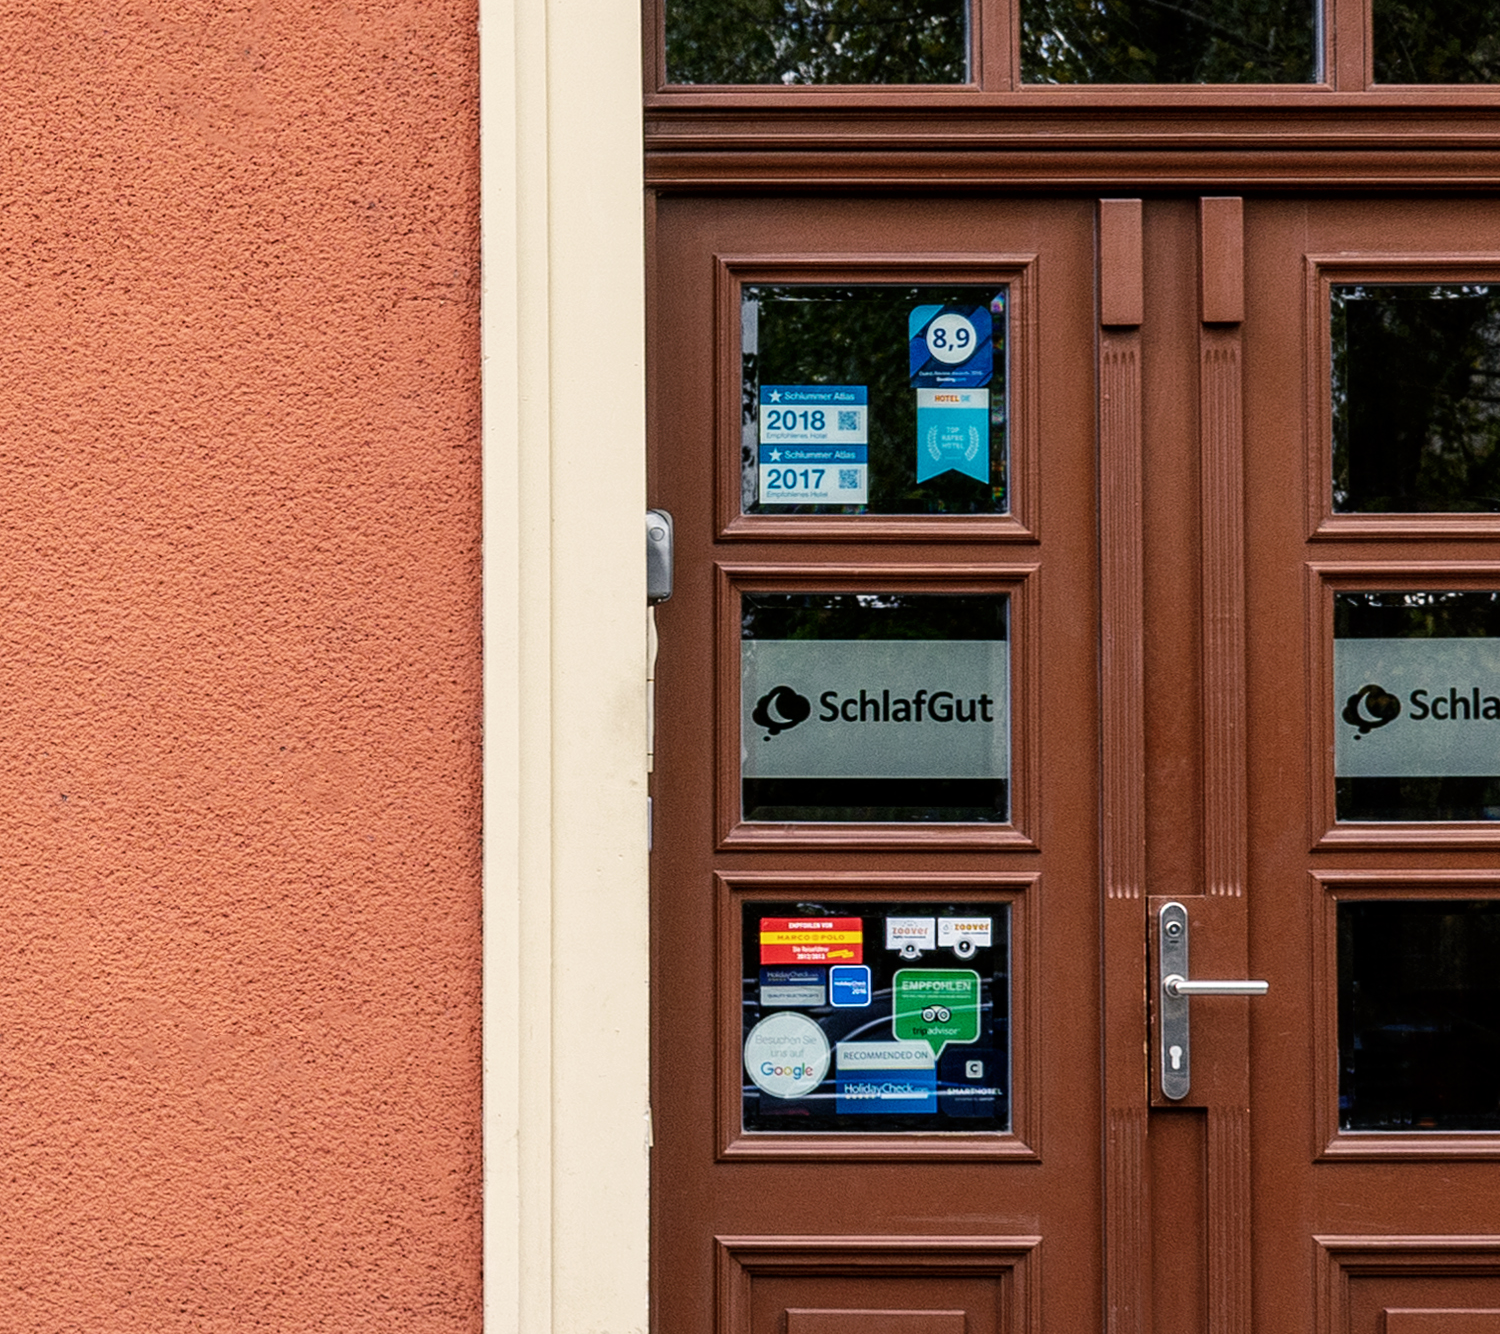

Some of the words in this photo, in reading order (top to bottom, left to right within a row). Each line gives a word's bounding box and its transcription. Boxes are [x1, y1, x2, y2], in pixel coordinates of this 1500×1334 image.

[933, 327, 970, 351] 8,9
[784, 391, 832, 401] Schlummer
[833, 391, 855, 401] Atlas
[934, 394, 960, 402] HOTEL
[766, 409, 826, 431] 2018
[784, 450, 832, 459] Schlummer
[834, 450, 856, 459] Atlas
[767, 468, 826, 489] 2017
[819, 689, 994, 722] SchlafGut
[892, 927, 929, 935] zoover
[954, 923, 990, 931] zoover
[902, 981, 971, 991] EMPFOHLEN
[912, 1026, 959, 1036] tripadvisor
[755, 1035, 801, 1045] Besuchen
[802, 1035, 817, 1045] Sie
[789, 1049, 805, 1057] auf
[843, 1051, 913, 1060] RECOMMENDED
[914, 1050, 928, 1059] ON
[760, 1061, 813, 1080] Google
